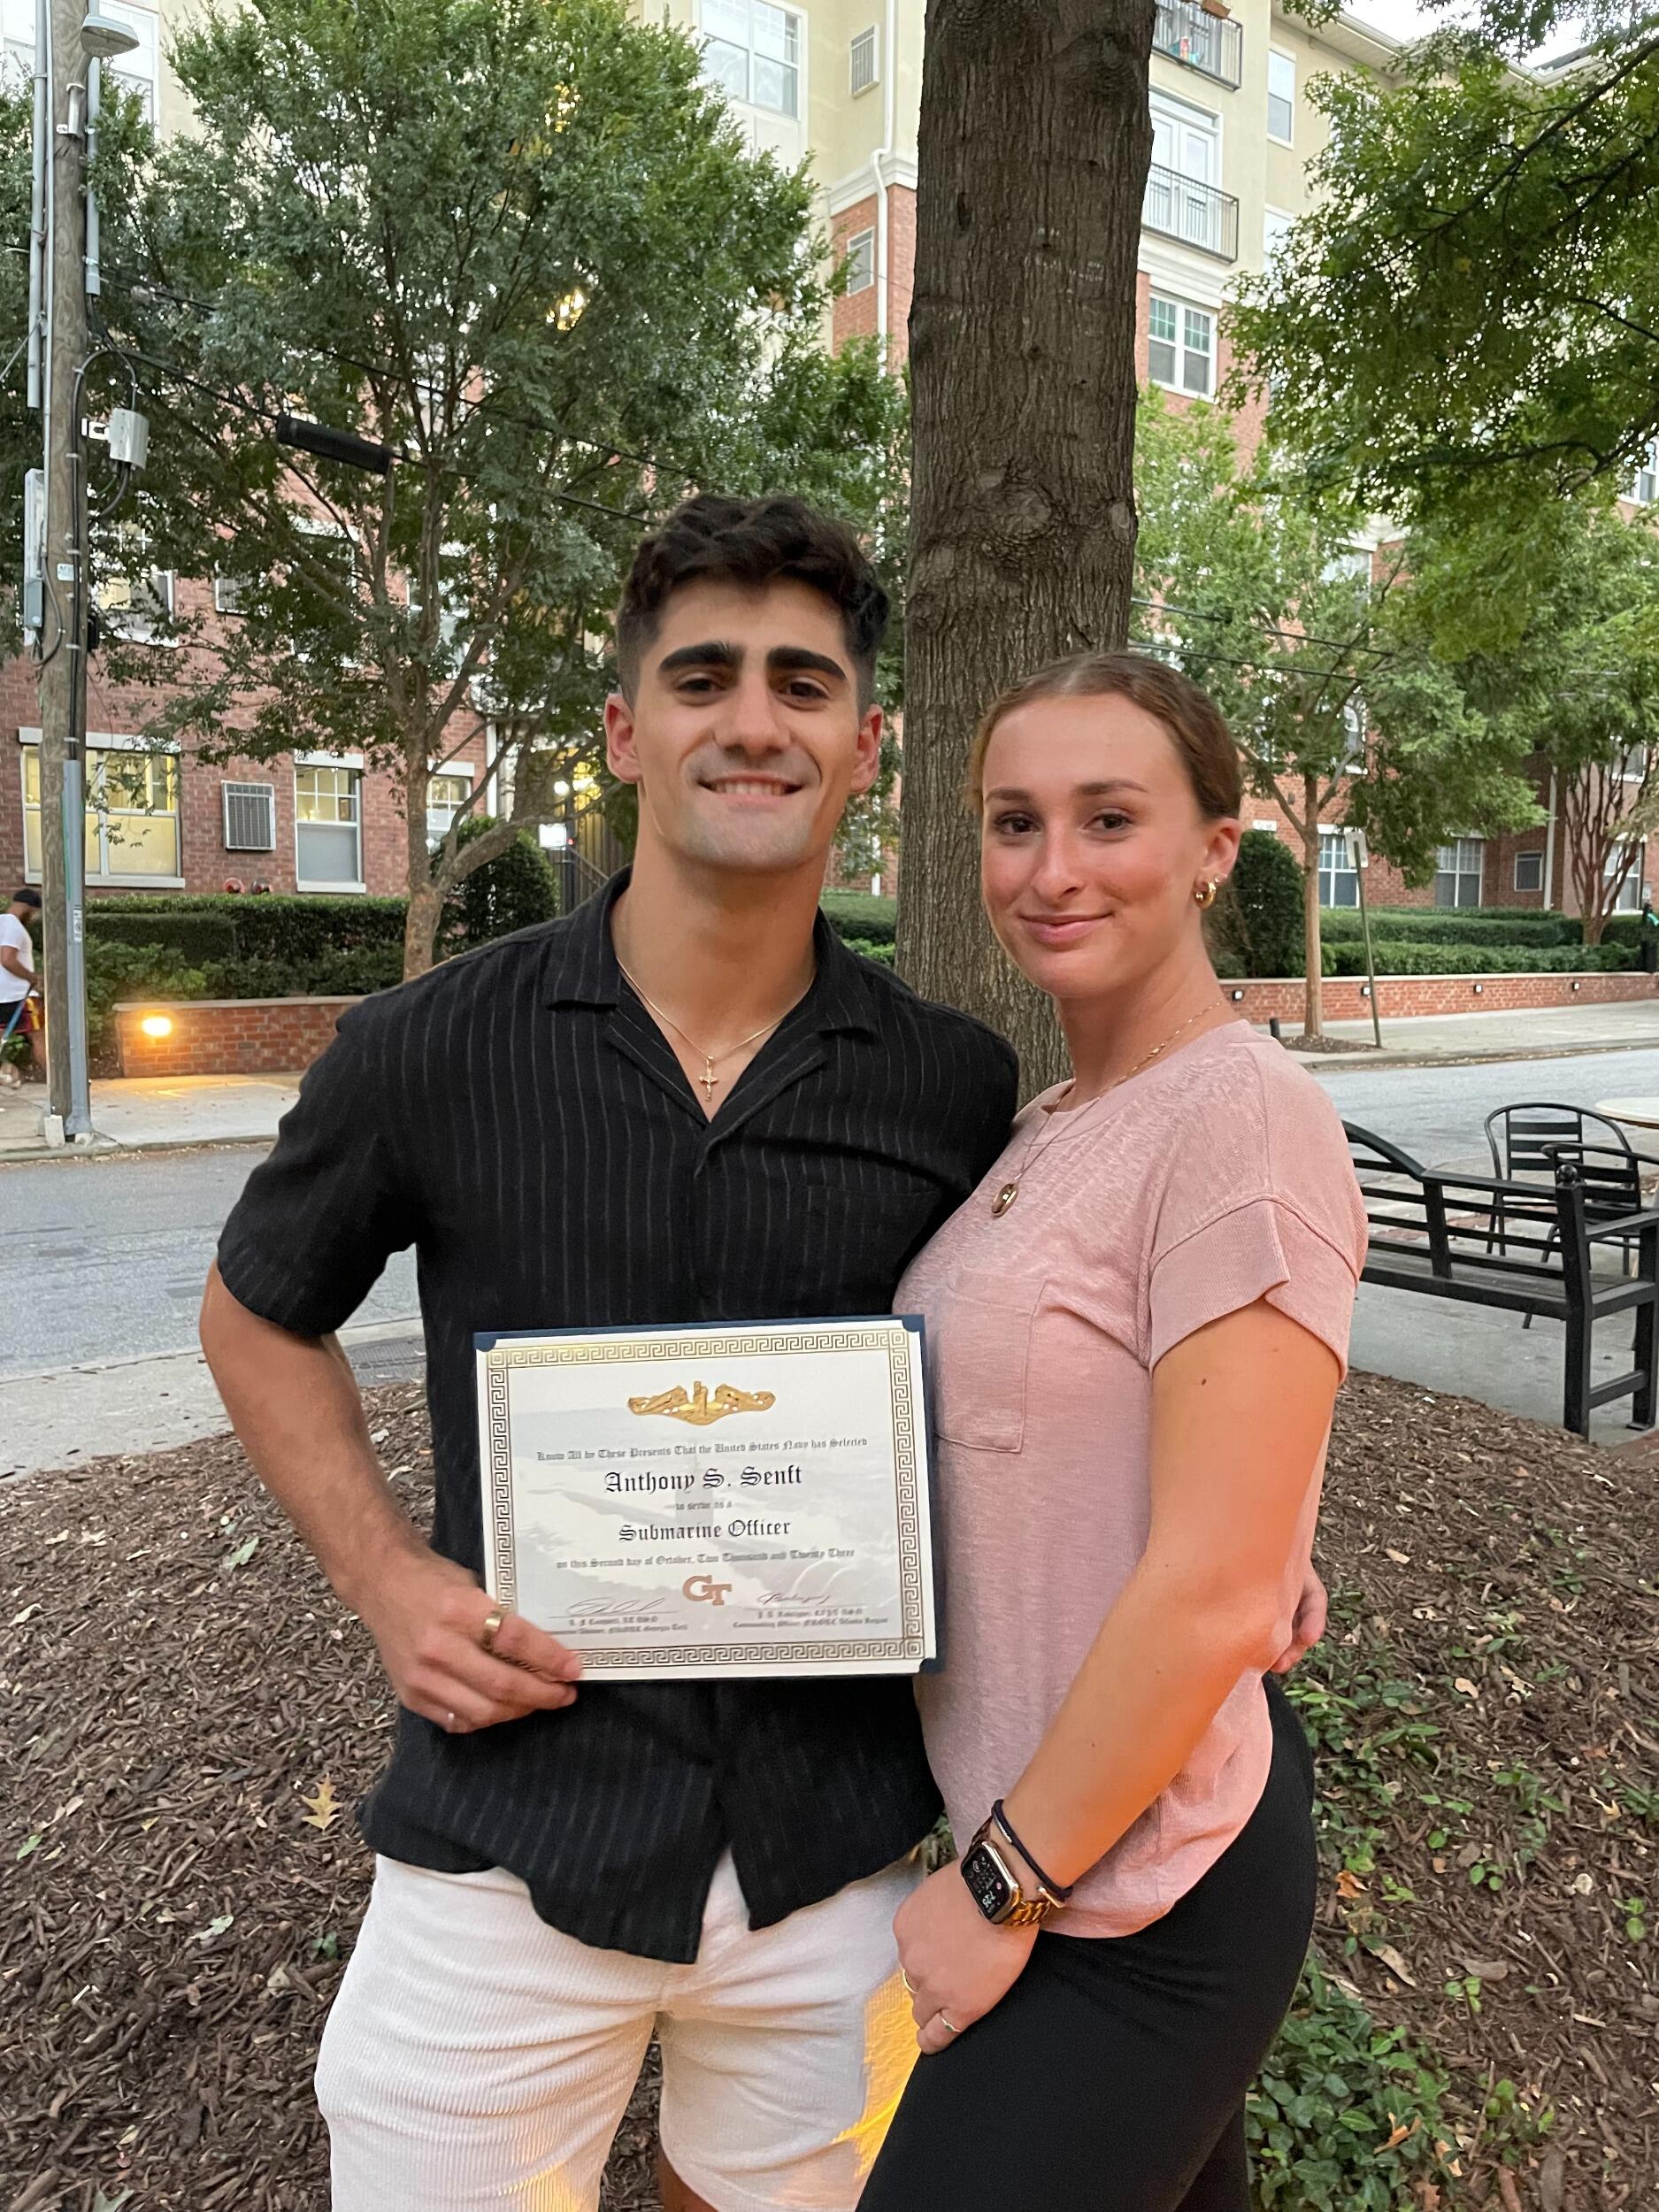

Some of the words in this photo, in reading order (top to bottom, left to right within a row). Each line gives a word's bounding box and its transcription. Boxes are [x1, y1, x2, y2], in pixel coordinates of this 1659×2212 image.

[598, 1448, 626, 1458] These
[630, 1448, 671, 1457] Presents
[674, 1445, 696, 1455] That
[699, 1443, 711, 1453] the
[715, 1443, 746, 1453] United
[749, 1441, 780, 1451] States
[782, 1440, 809, 1451] Navy
[811, 1439, 826, 1448] has
[829, 1438, 868, 1448] Selected
[604, 1471, 695, 1494] Anthony
[703, 1468, 732, 1489] S.
[740, 1464, 803, 1487] Senft
[618, 1523, 722, 1541] Submarine
[727, 1519, 791, 1538] Officer
[682, 1574, 733, 1606] GT
